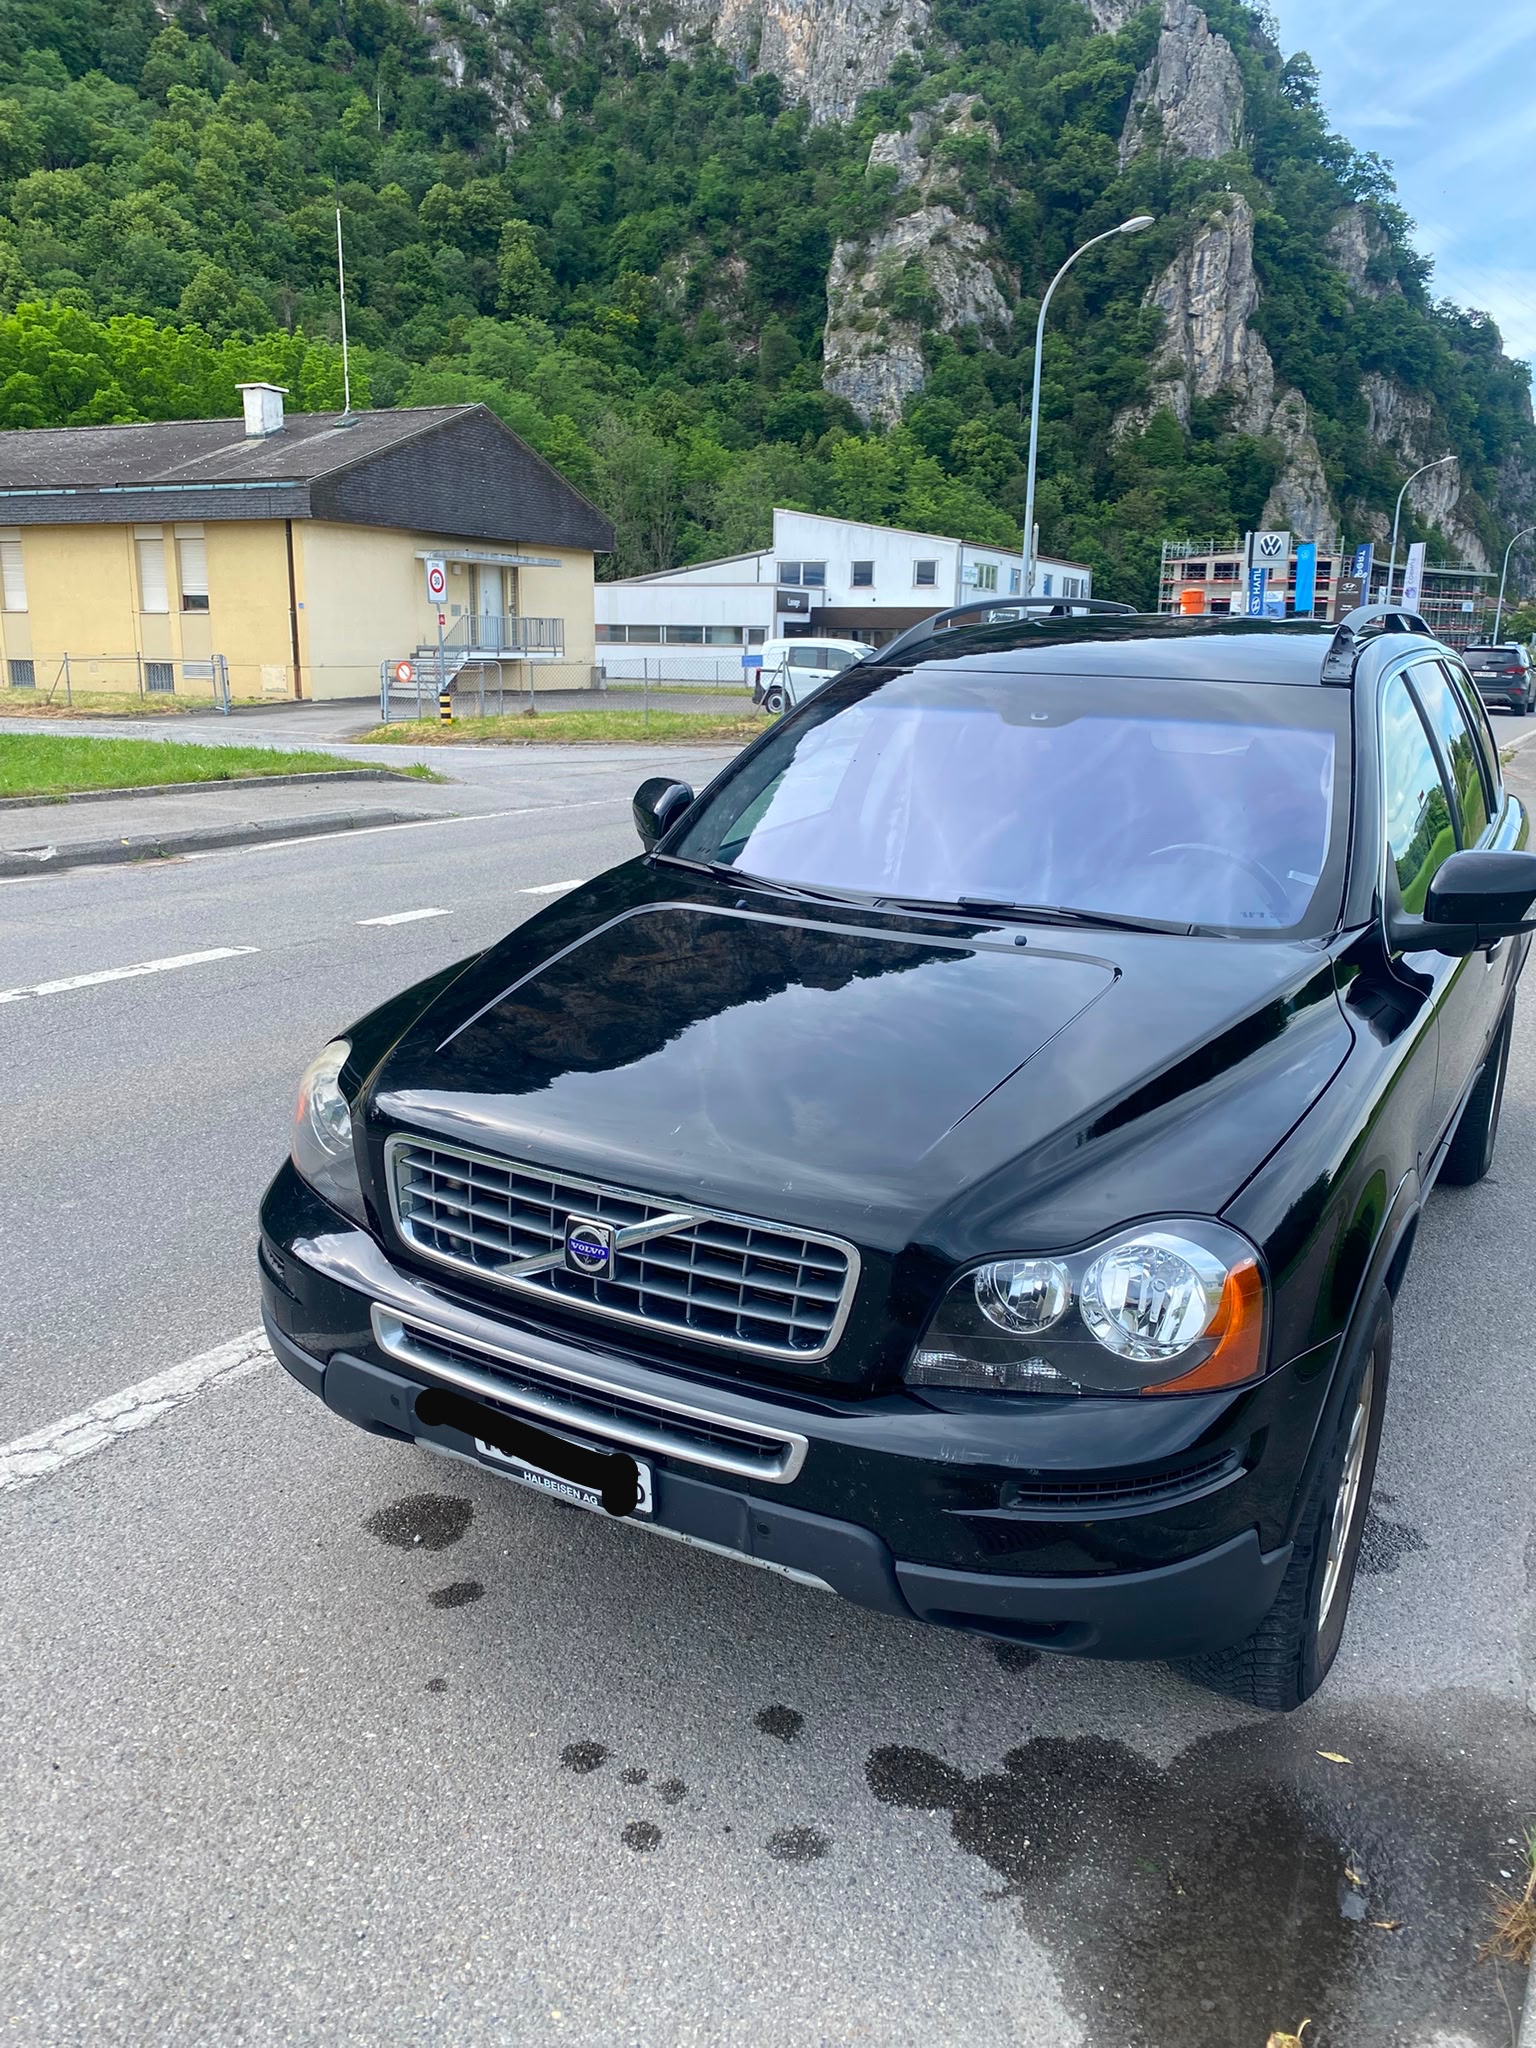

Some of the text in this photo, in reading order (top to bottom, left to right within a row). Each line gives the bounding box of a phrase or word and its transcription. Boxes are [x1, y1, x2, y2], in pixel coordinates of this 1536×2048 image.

[570, 1240, 605, 1256] VOLVO
[523, 1471, 599, 1506] HALBEISEN AG
